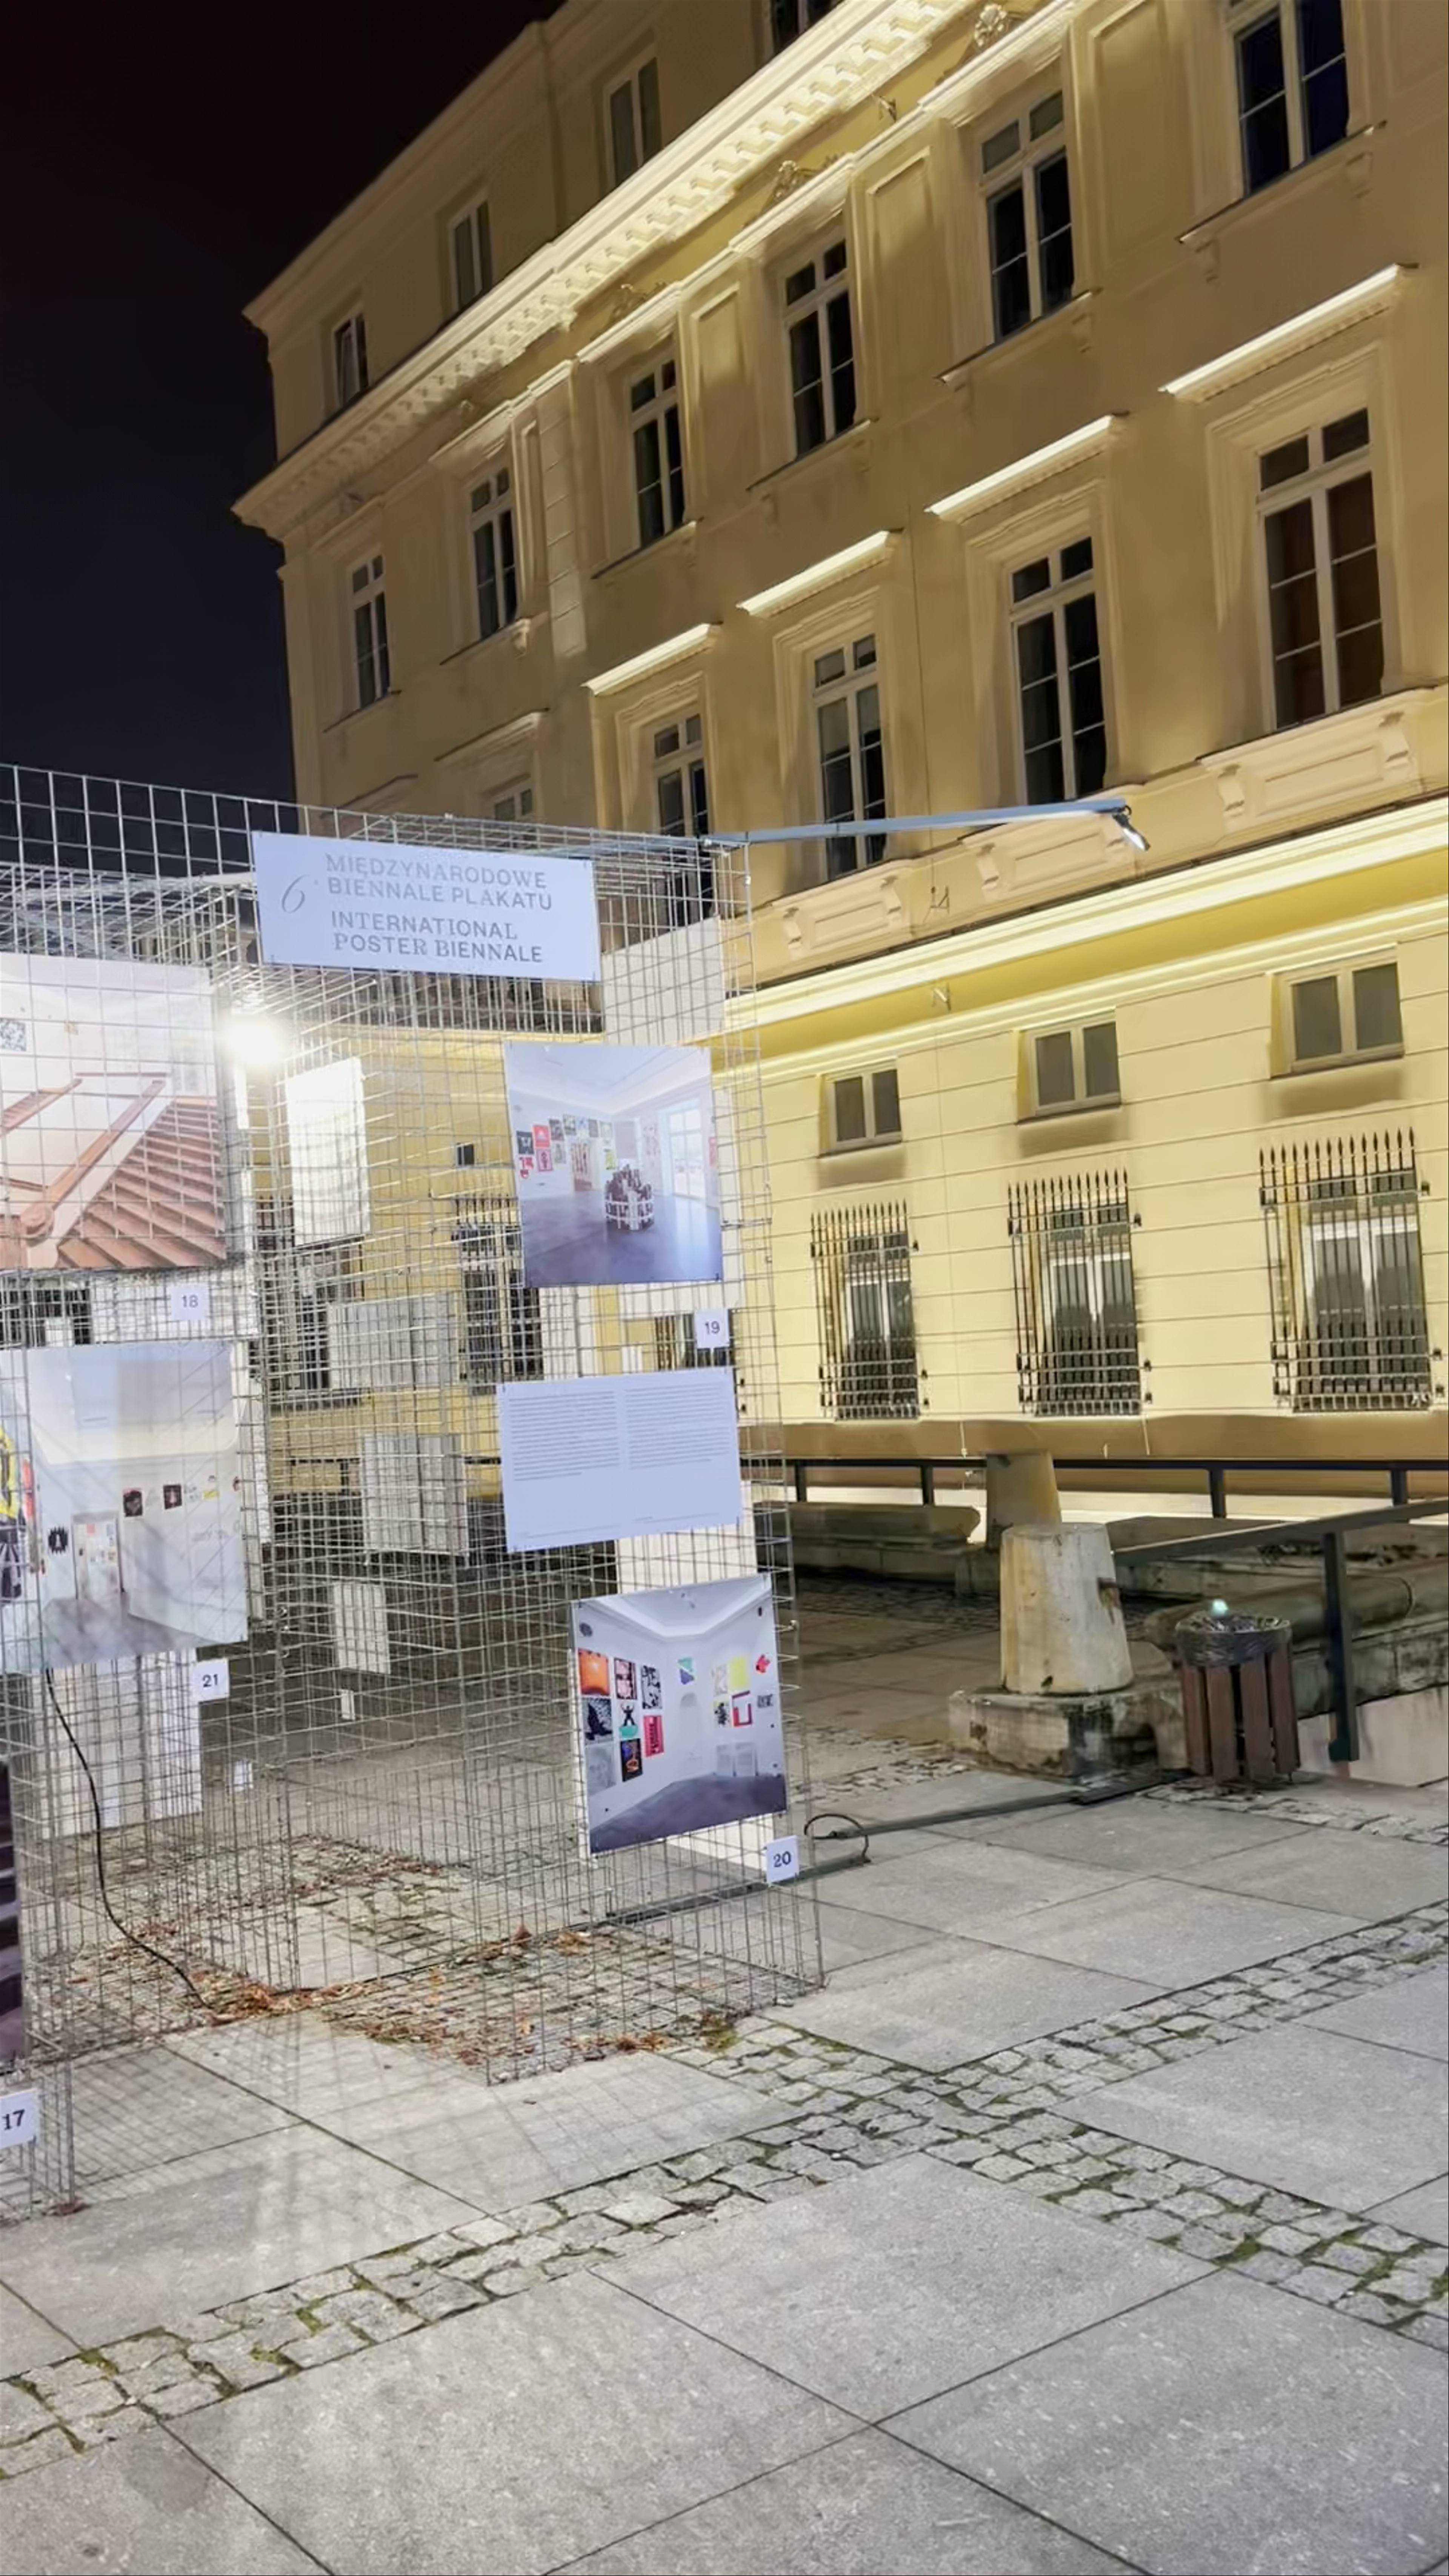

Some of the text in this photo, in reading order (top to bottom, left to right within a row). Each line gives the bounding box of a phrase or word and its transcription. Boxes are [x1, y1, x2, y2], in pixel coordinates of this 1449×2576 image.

[325, 853, 547, 889] MIĘDZYNARODOWE
[328, 876, 552, 910] BIENNALE PLAKATU
[332, 910, 518, 940] INTERNATIONAL
[333, 932, 543, 963] POSTER BIENNALE
[182, 1295, 198, 1308] 18
[705, 1320, 720, 1335] 19
[202, 1673, 218, 1687] 21
[773, 1850, 792, 1867] 20
[2, 2108, 25, 2130] 17
